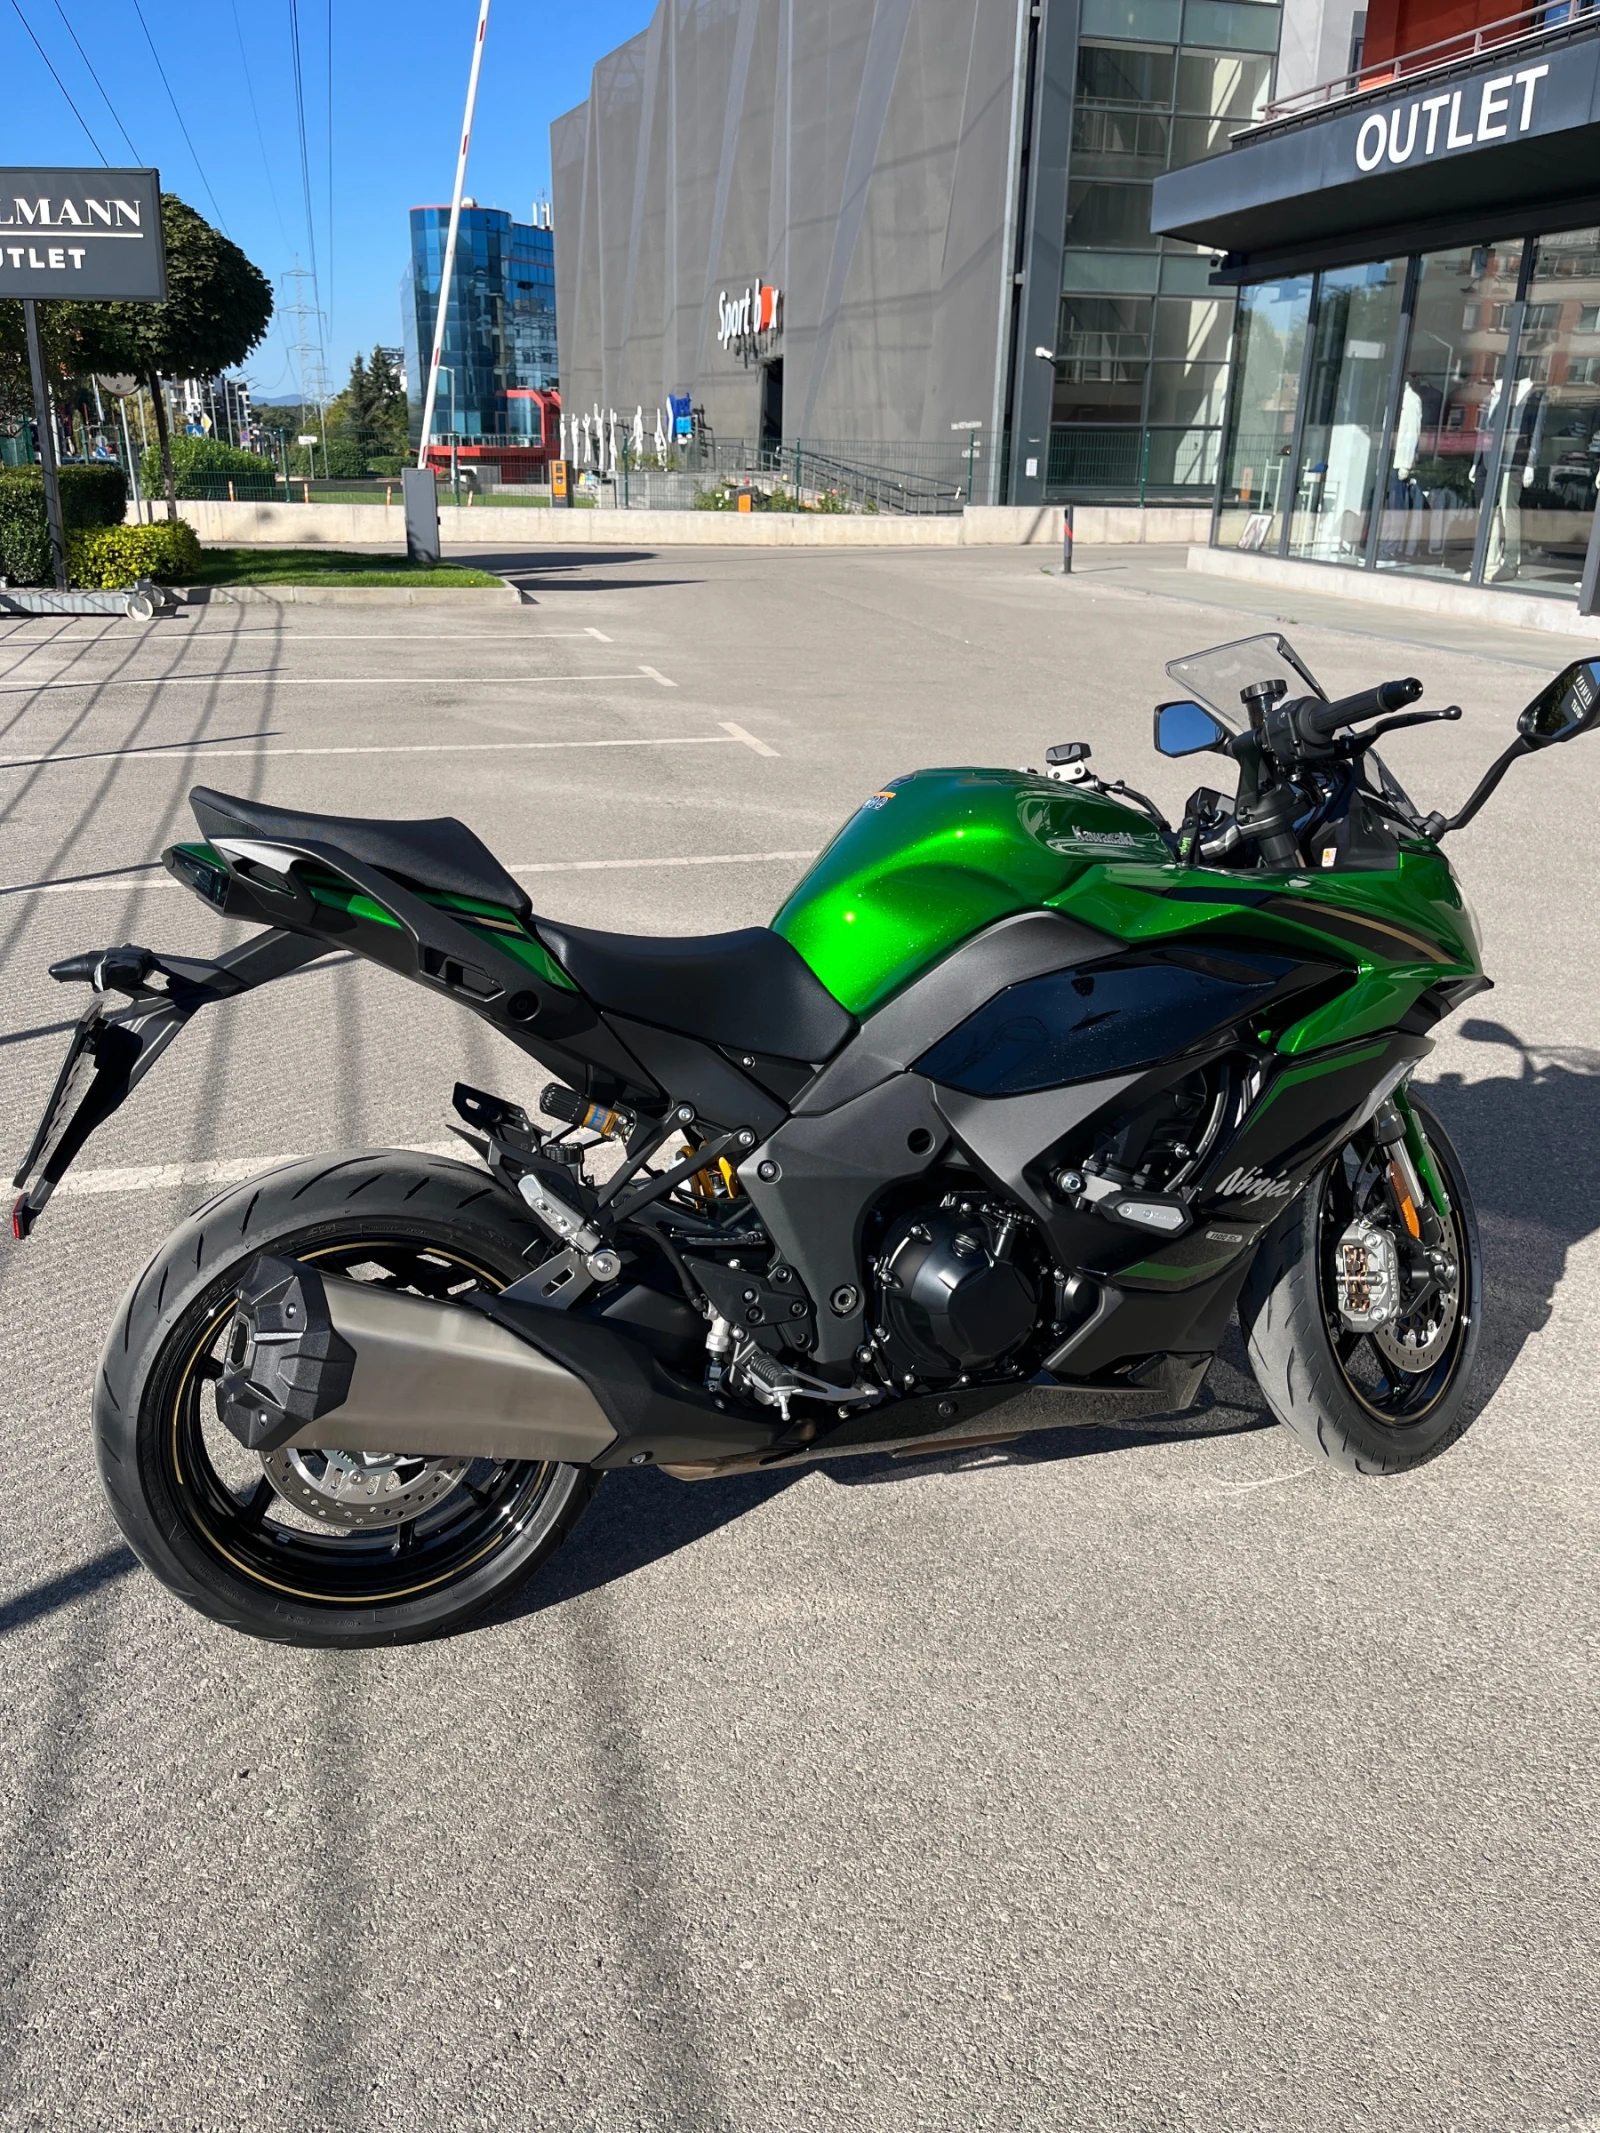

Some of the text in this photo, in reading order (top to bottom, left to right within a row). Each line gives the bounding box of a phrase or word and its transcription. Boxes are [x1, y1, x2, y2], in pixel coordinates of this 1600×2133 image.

[1355, 64, 1549, 172] OUTLET
[0, 247, 86, 269] TLET
[717, 287, 751, 351] Sport
[1071, 824, 1136, 846] Kawasaki
[1215, 1166, 1291, 1207] Ninja
